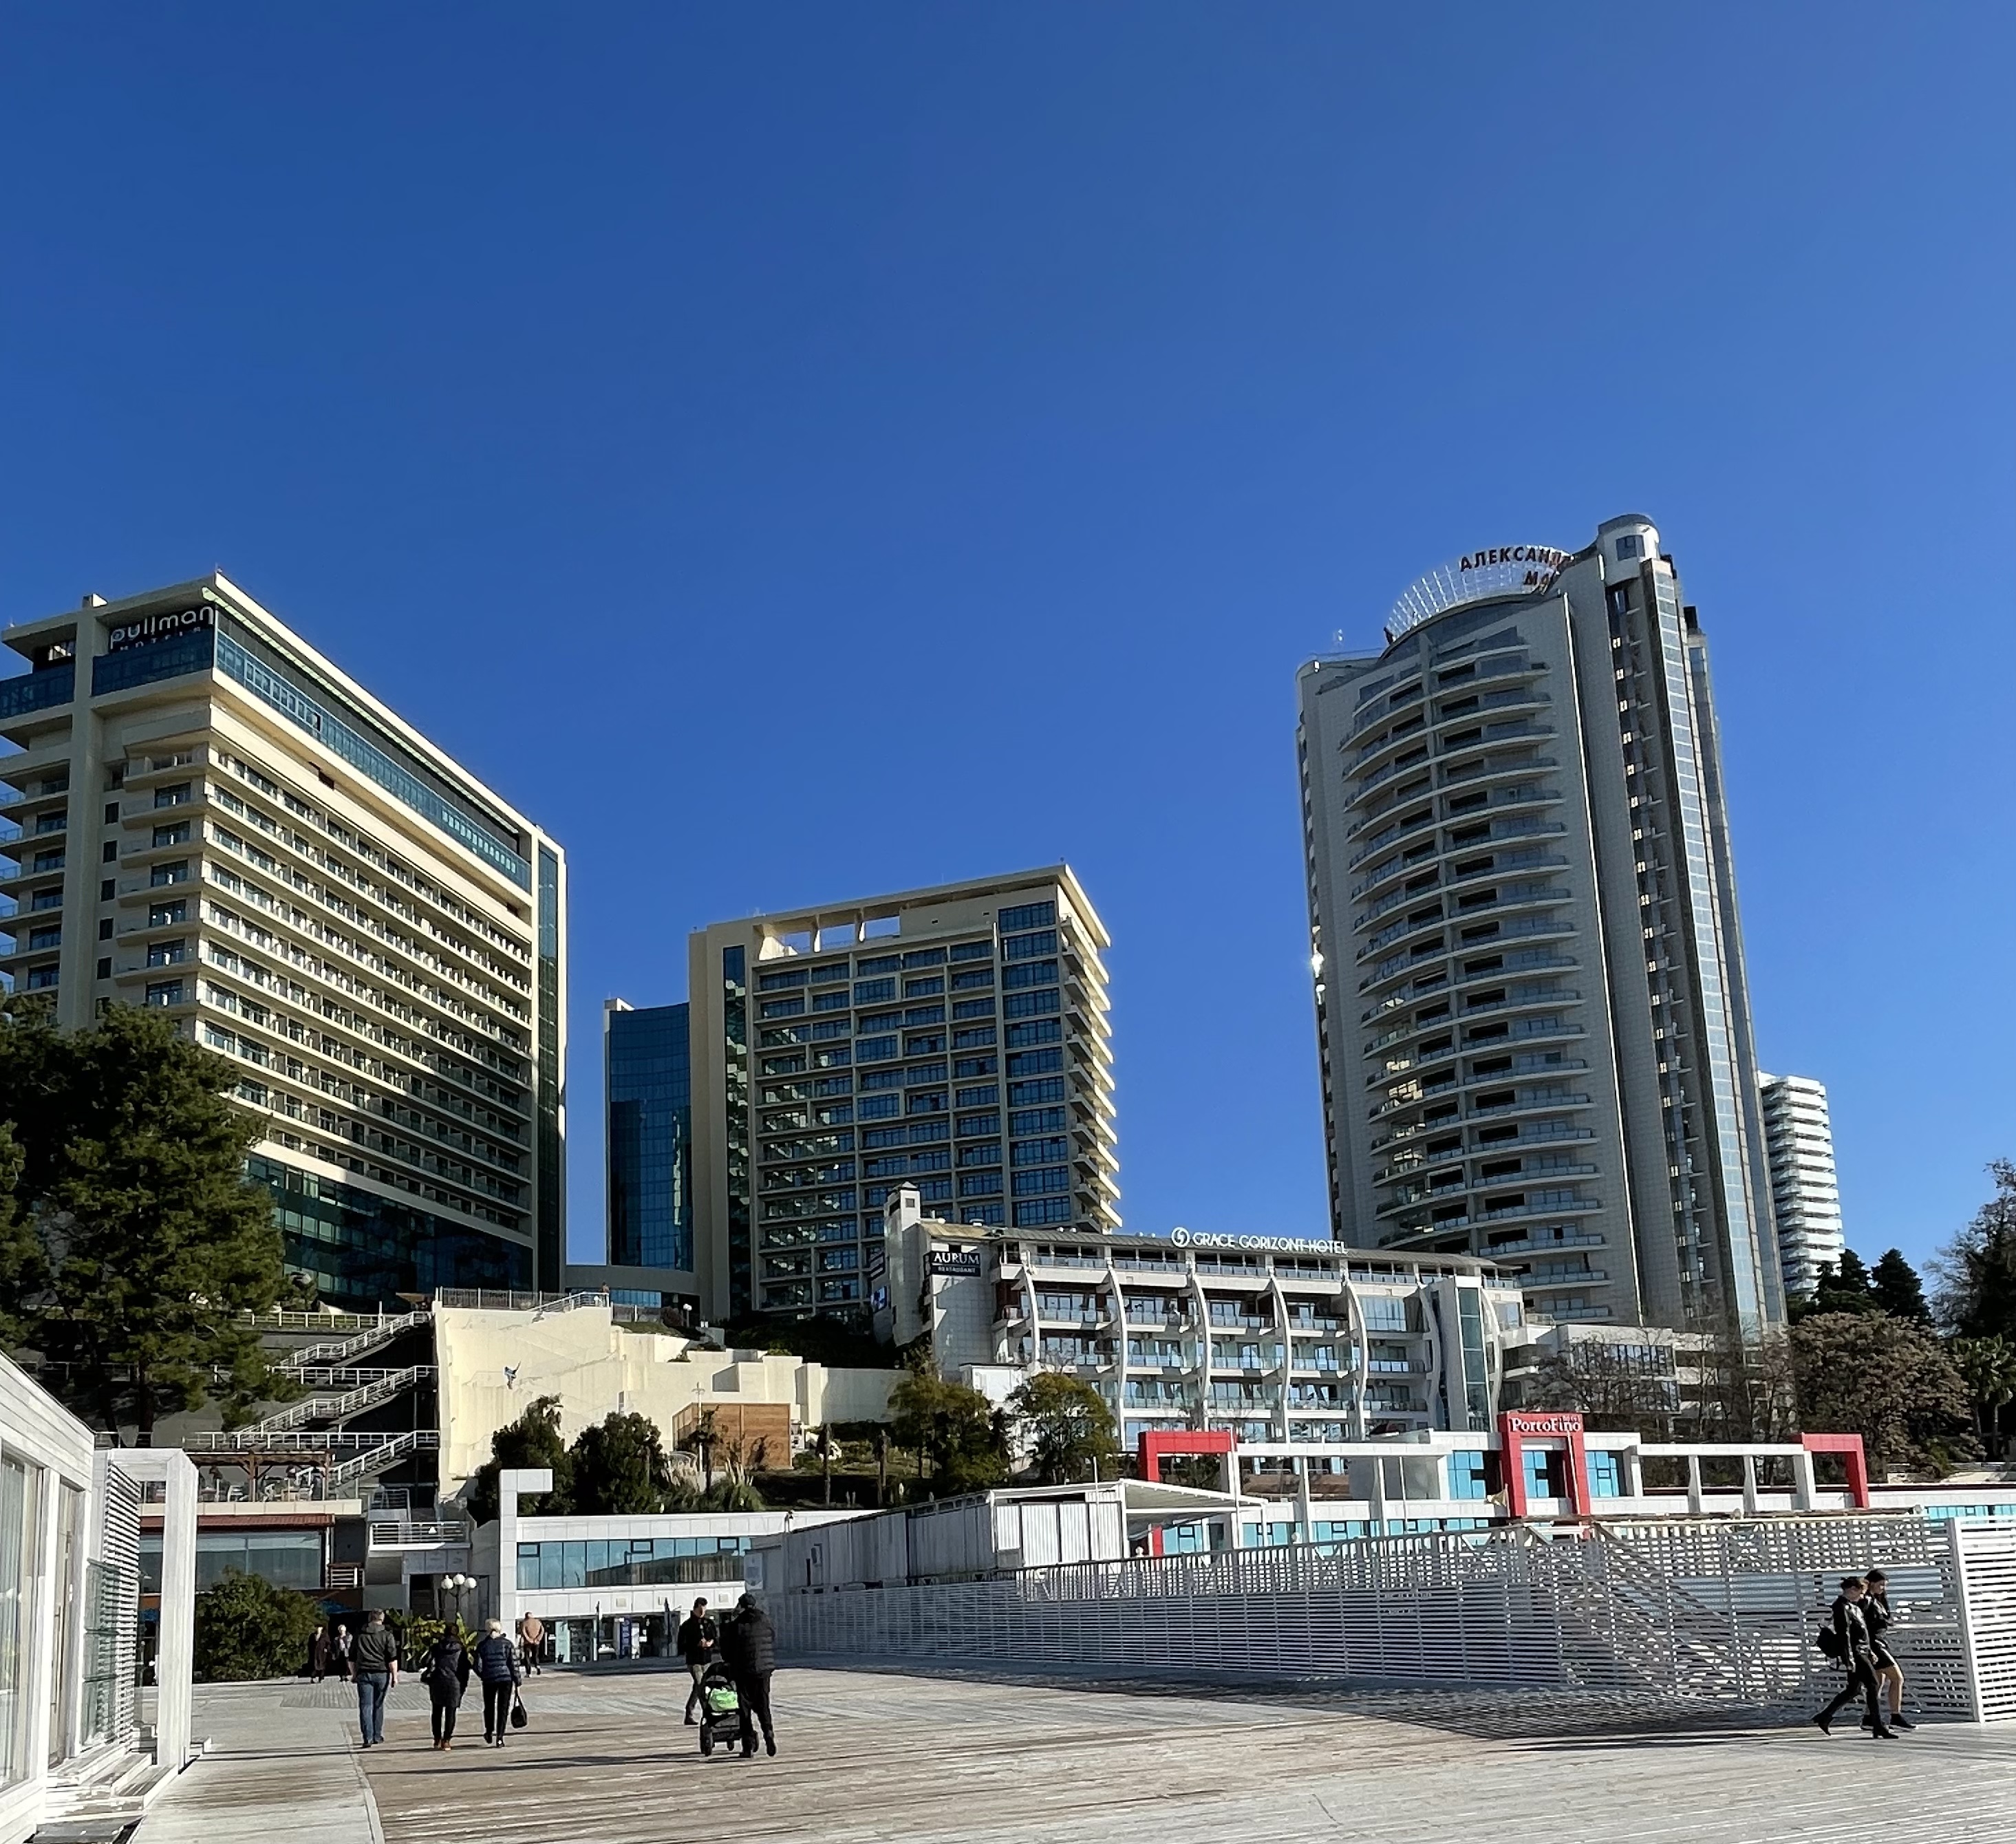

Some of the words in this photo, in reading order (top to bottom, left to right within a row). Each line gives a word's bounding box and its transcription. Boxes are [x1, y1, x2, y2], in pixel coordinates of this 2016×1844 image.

[1460, 546, 1571, 572] АЛЕКСАНД
[1523, 570, 1551, 586] МА
[110, 605, 214, 650] pullman
[1192, 1232, 1234, 1247] GRACE
[1238, 1234, 1305, 1252] GORIZONT
[1308, 1239, 1348, 1255] HOTEL
[934, 1252, 980, 1265] AURUM
